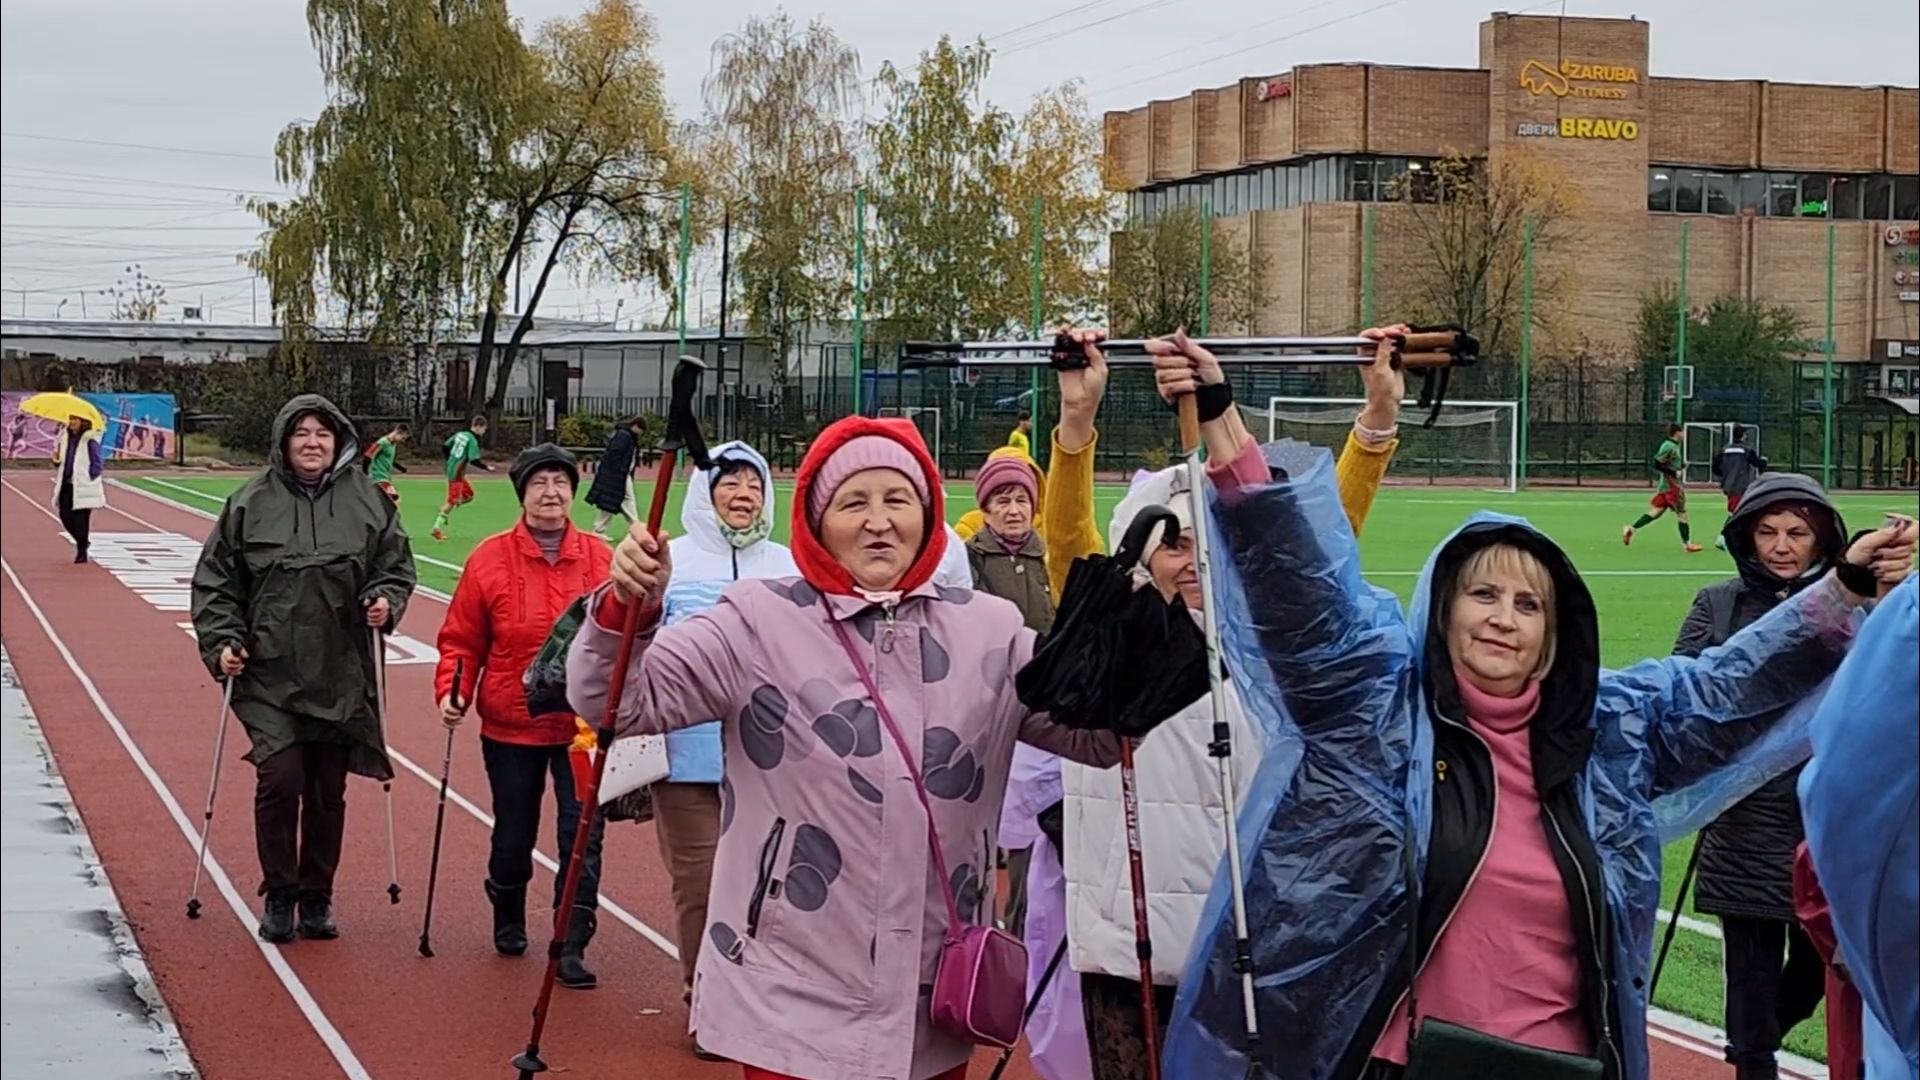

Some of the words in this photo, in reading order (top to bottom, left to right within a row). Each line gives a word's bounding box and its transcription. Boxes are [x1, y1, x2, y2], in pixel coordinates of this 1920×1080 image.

[1569, 64, 1637, 82] ZARUBA
[1517, 123, 1557, 136] ДВЕРИ
[1560, 117, 1638, 139] BRAVO
